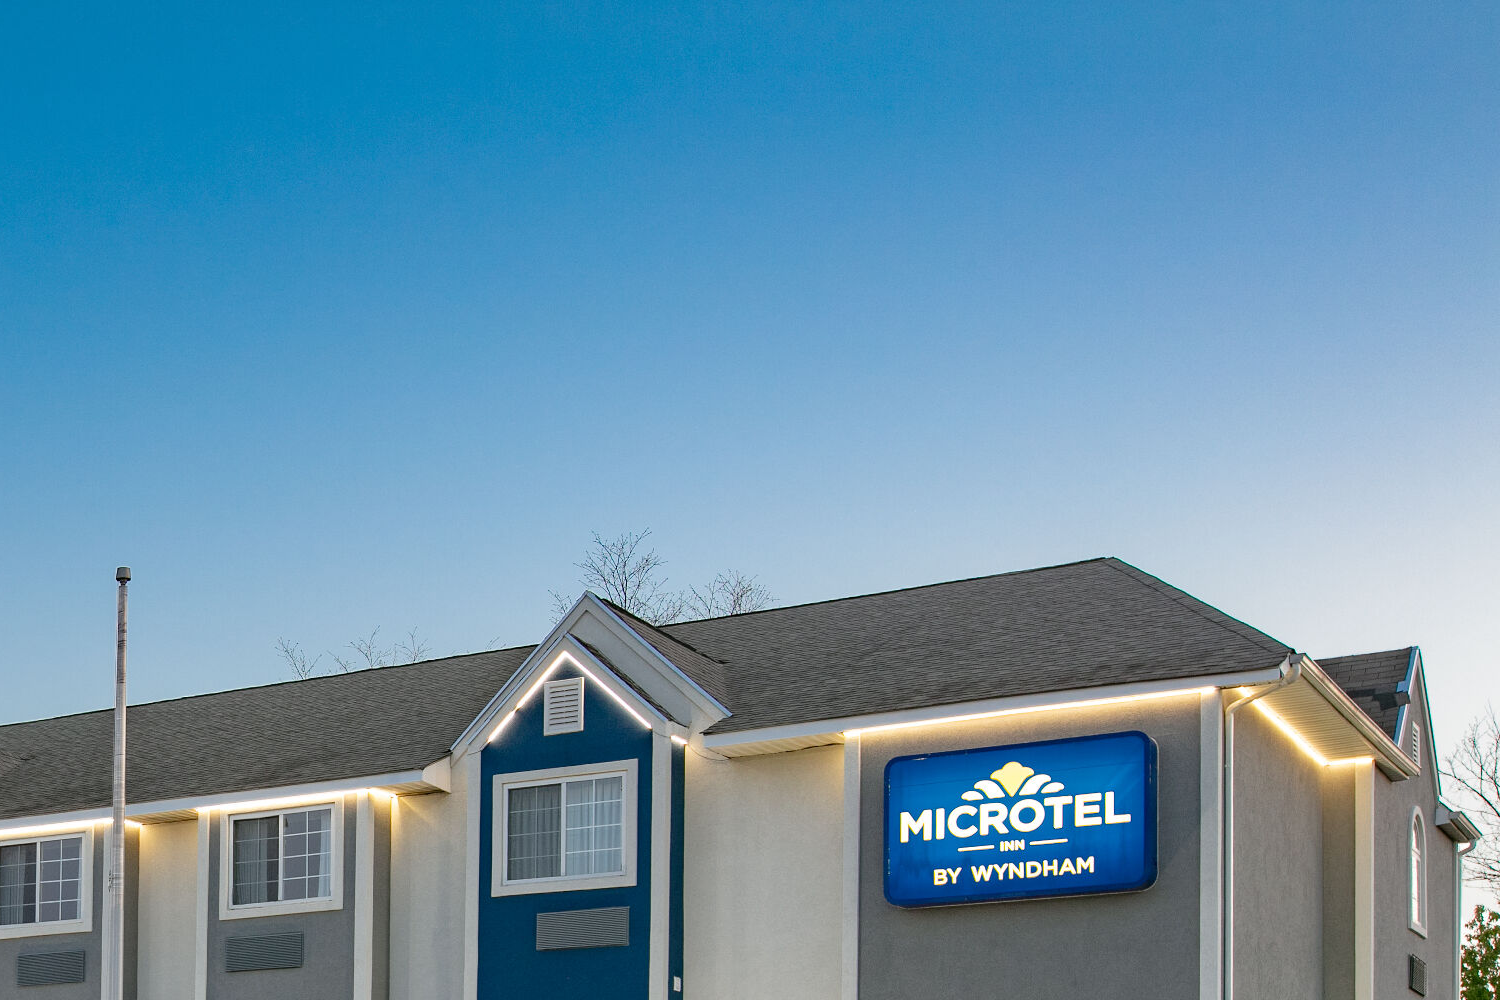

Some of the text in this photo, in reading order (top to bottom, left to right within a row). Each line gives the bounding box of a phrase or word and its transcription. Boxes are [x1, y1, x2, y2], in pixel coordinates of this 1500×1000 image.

[900, 791, 1132, 843] MICROTEL
[1000, 839, 1025, 852] INN
[933, 856, 1095, 886] BY WYNDHAM
